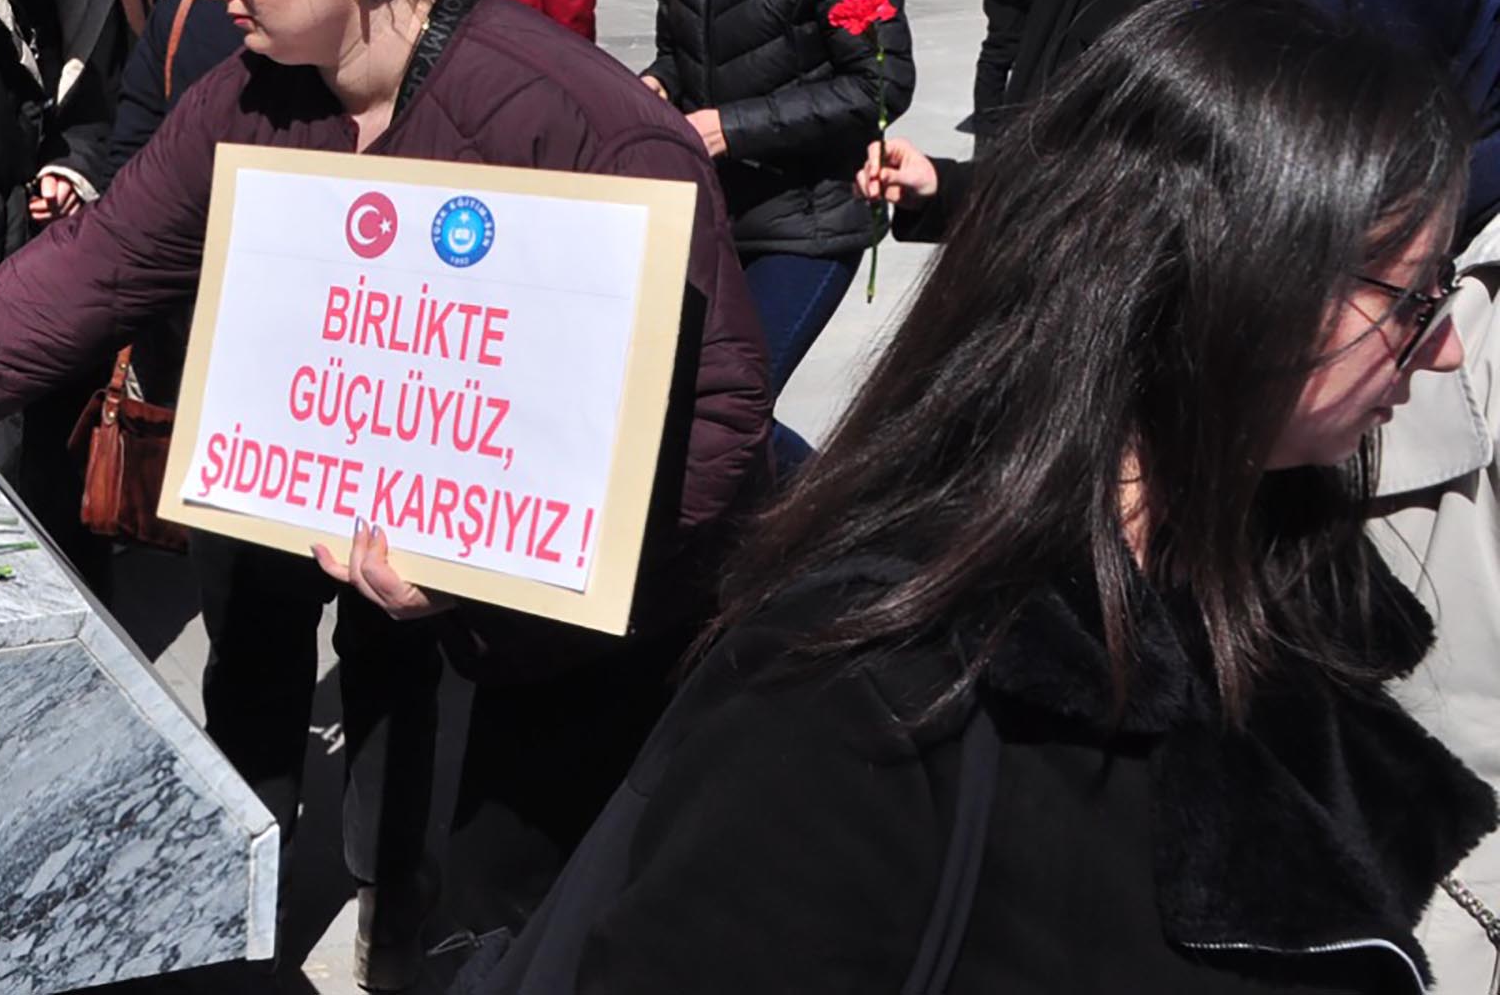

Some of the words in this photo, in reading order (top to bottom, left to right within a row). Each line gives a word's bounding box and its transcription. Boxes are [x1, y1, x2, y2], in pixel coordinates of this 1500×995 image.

[433, 208, 448, 244] TÜRK
[323, 275, 510, 367] BİRLİKTE
[289, 357, 514, 471] GÜÇLÜYÜZ,
[199, 423, 364, 518] ŞİDDETE
[370, 467, 570, 563] KARŞIYIZ
